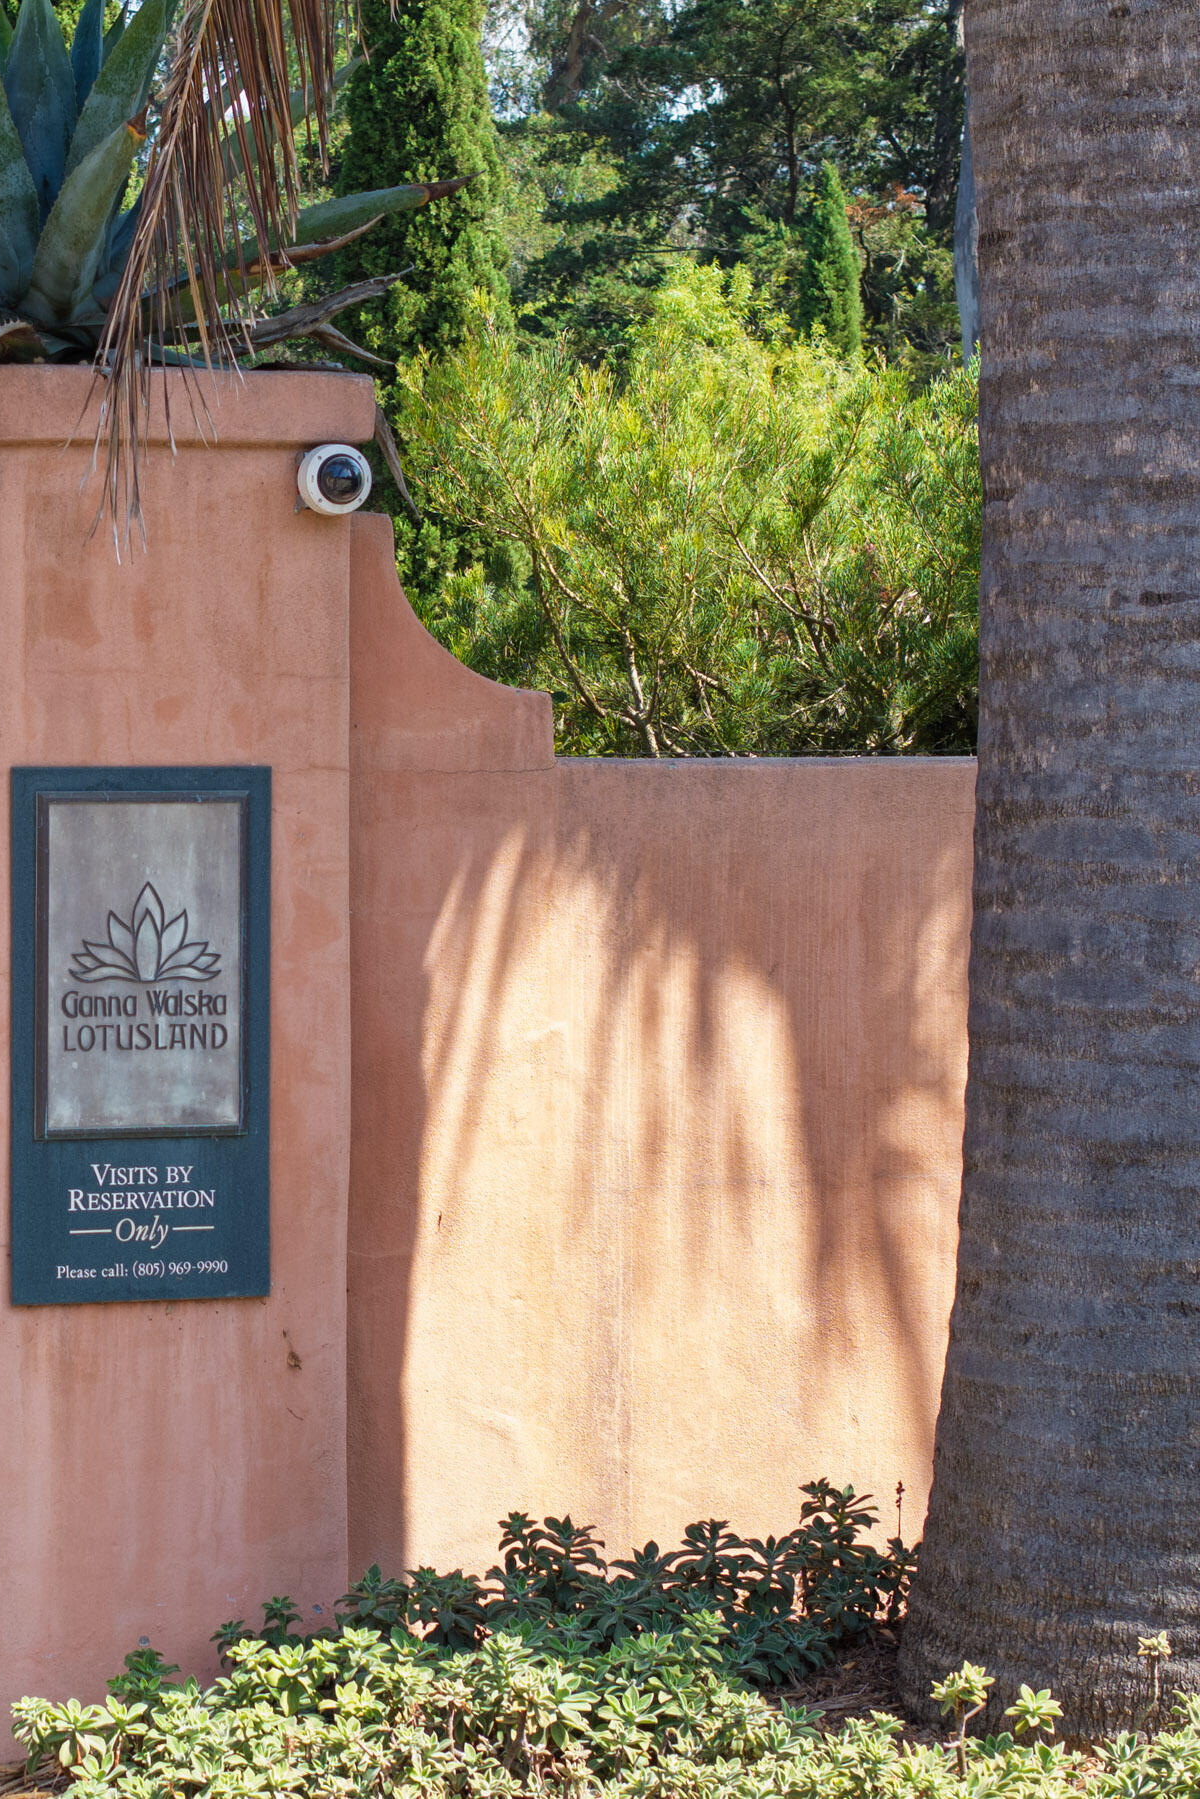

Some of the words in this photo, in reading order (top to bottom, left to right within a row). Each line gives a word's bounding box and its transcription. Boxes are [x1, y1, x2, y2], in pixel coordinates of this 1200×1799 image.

[61, 990, 137, 1018] Ganna
[146, 989, 227, 1017] Walska
[63, 1022, 228, 1052] LOTUSLAND
[115, 1214, 169, 1249] Only
[56, 1264, 97, 1280] Please
[101, 1263, 128, 1277] call:
[132, 1259, 165, 1280] (805)
[168, 1259, 228, 1276] 969-9990
